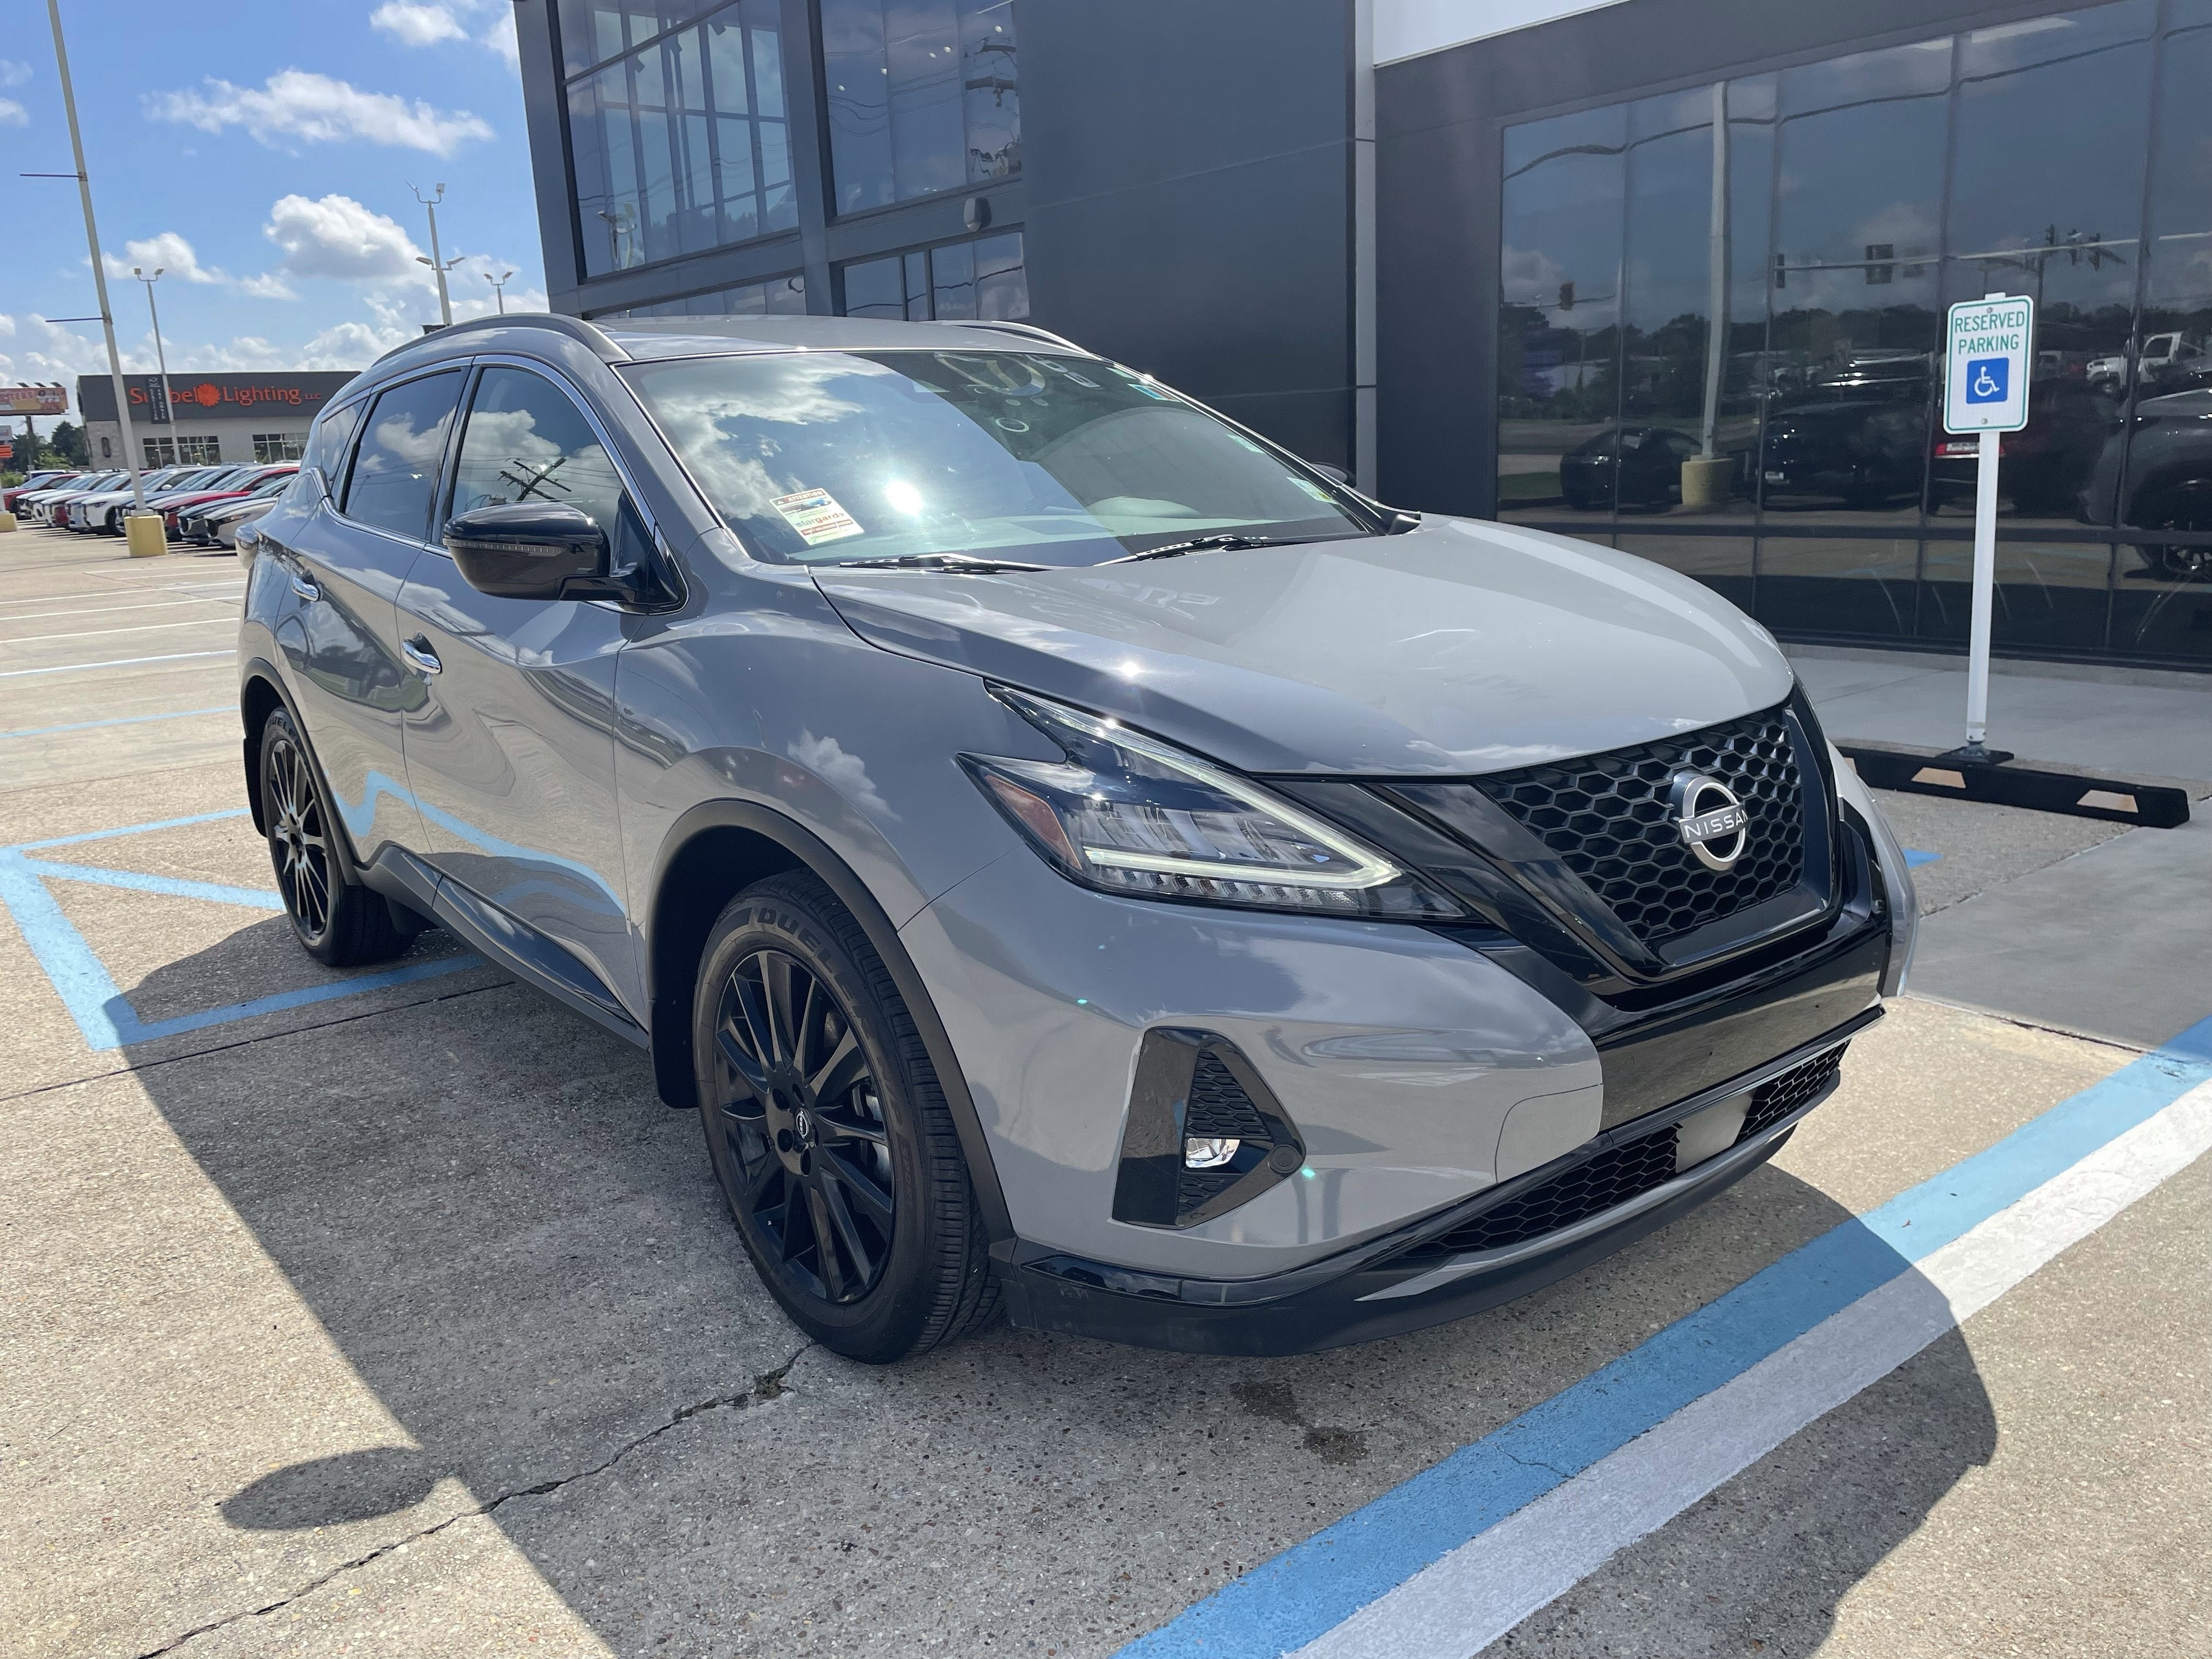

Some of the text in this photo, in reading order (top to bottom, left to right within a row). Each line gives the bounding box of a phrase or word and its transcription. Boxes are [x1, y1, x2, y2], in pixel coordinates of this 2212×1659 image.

[1954, 311, 2025, 333] RESERVED
[1958, 334, 2019, 354] PARKING
[223, 386, 302, 406] Lighting
[788, 491, 823, 501] ATTENTION
[1684, 809, 1748, 838] NISSAN
